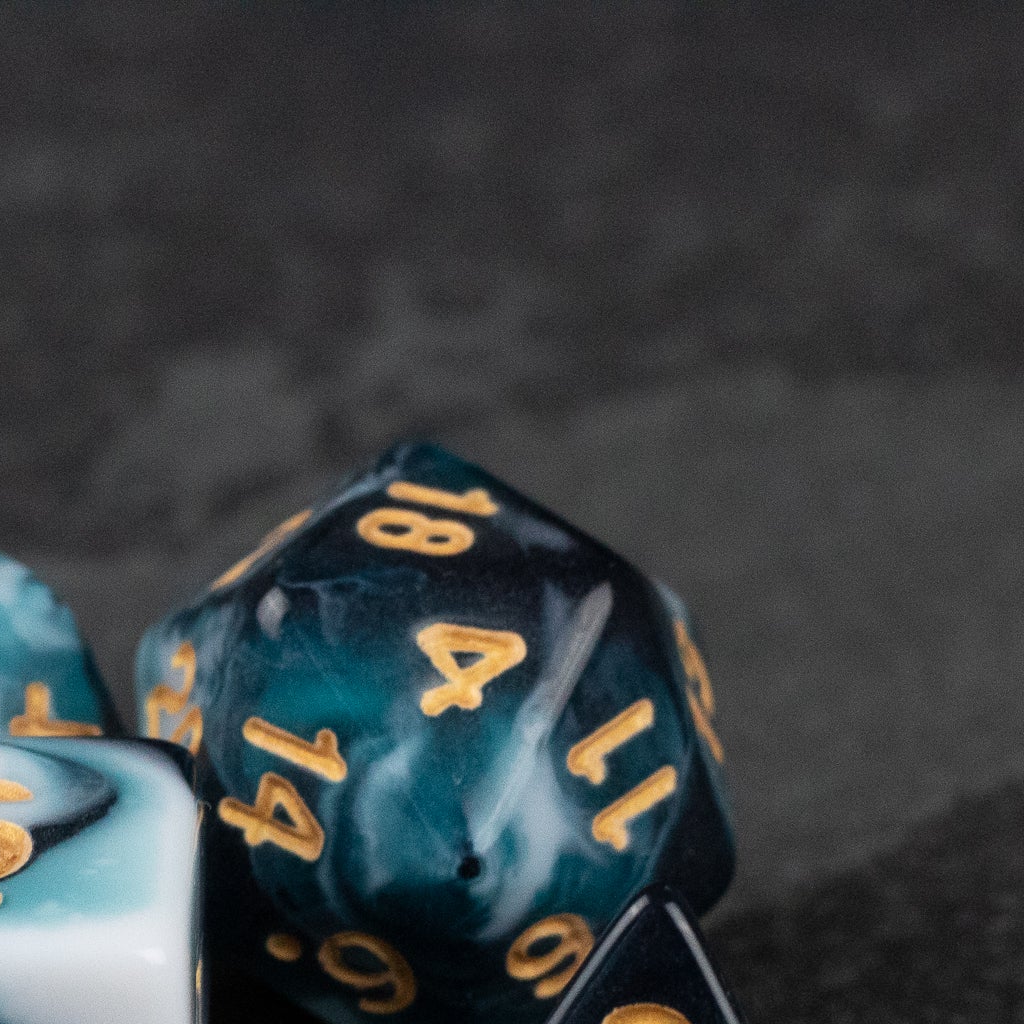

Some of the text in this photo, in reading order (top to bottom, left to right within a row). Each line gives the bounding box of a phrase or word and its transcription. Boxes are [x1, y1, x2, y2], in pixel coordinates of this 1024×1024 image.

[356, 481, 499, 557] 18
[416, 622, 528, 717] 4
[217, 716, 348, 861] 14
[566, 698, 677, 851] 11
